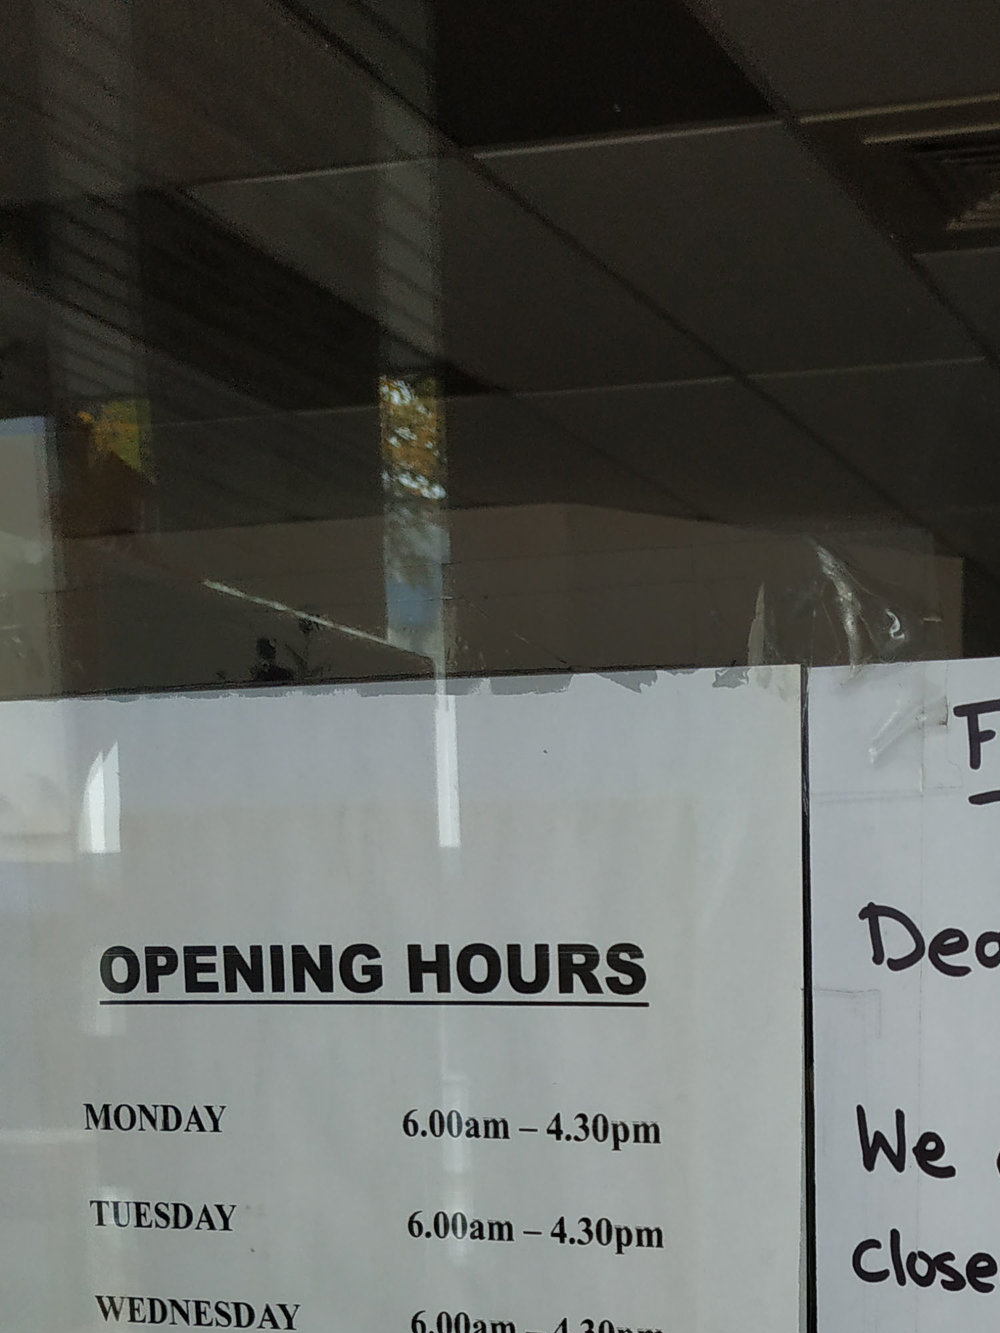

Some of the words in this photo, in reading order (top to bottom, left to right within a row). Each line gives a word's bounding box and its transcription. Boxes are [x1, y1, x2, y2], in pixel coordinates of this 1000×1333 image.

[99, 943, 384, 995] OPENING
[406, 943, 647, 996] HOURS
[82, 1103, 227, 1133] MONDAY
[402, 1108, 511, 1140] 6.00am
[546, 1112, 662, 1152] 4.30pm
[855, 1104, 957, 1179] We
[89, 1200, 237, 1232] TUESDAY
[407, 1210, 515, 1242] 6.00am
[550, 1216, 664, 1255] 4.30pm
[94, 1295, 301, 1331] WEDNESDAY
